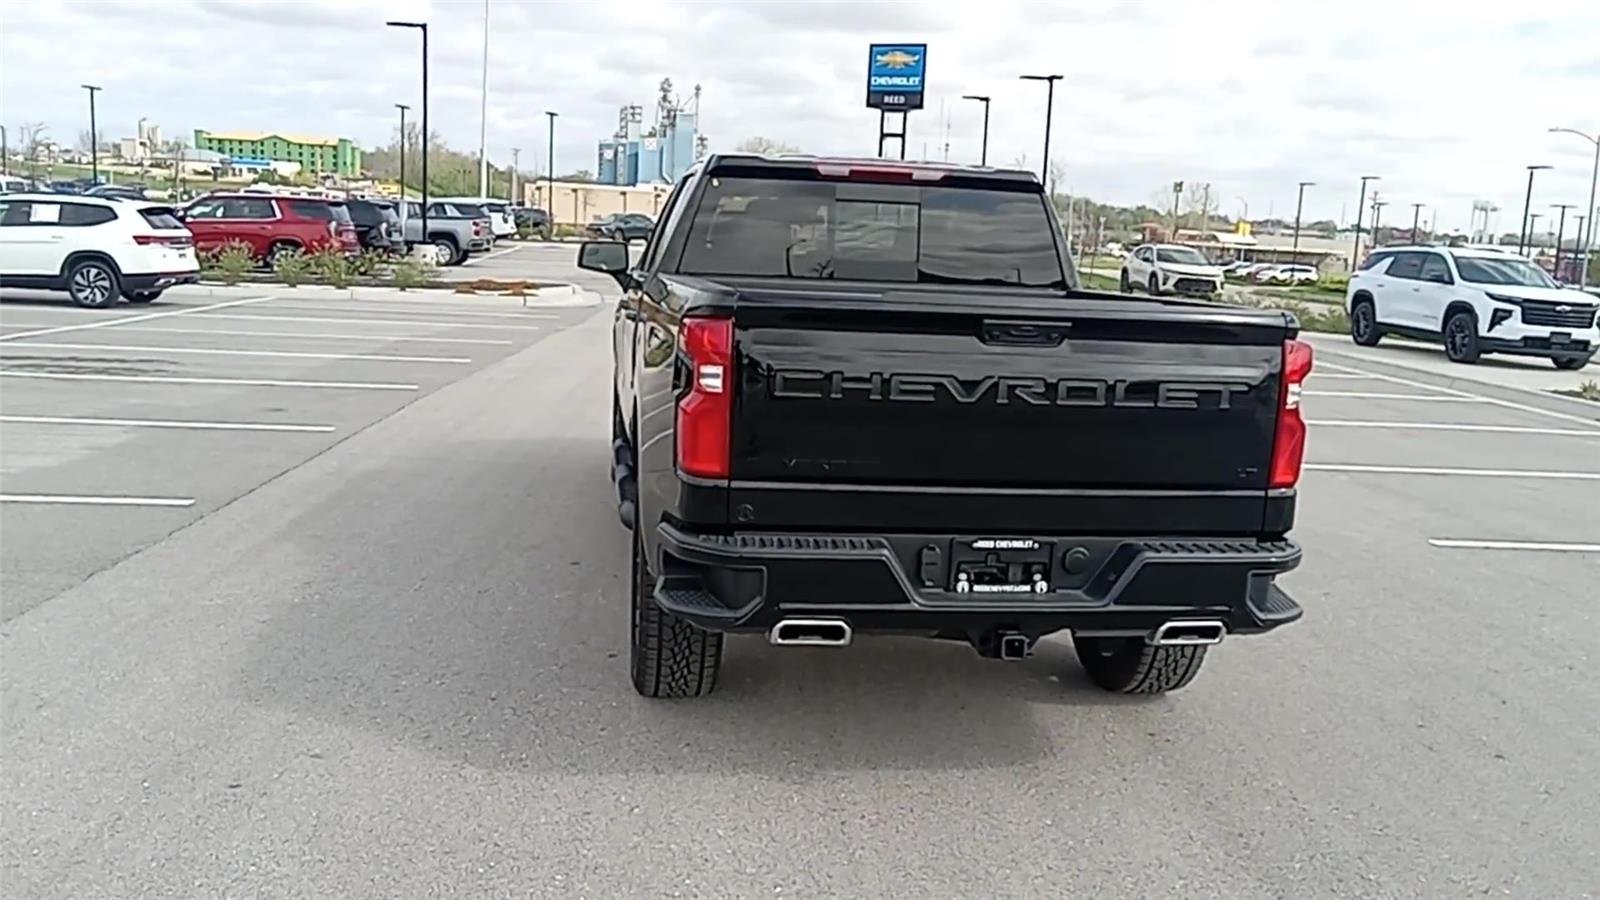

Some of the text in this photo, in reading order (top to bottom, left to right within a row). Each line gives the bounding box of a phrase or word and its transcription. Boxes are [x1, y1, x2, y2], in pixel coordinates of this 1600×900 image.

[871, 76, 920, 85] CHEVROLET
[883, 95, 905, 104] REED
[773, 371, 1250, 409] CHEVROLET
